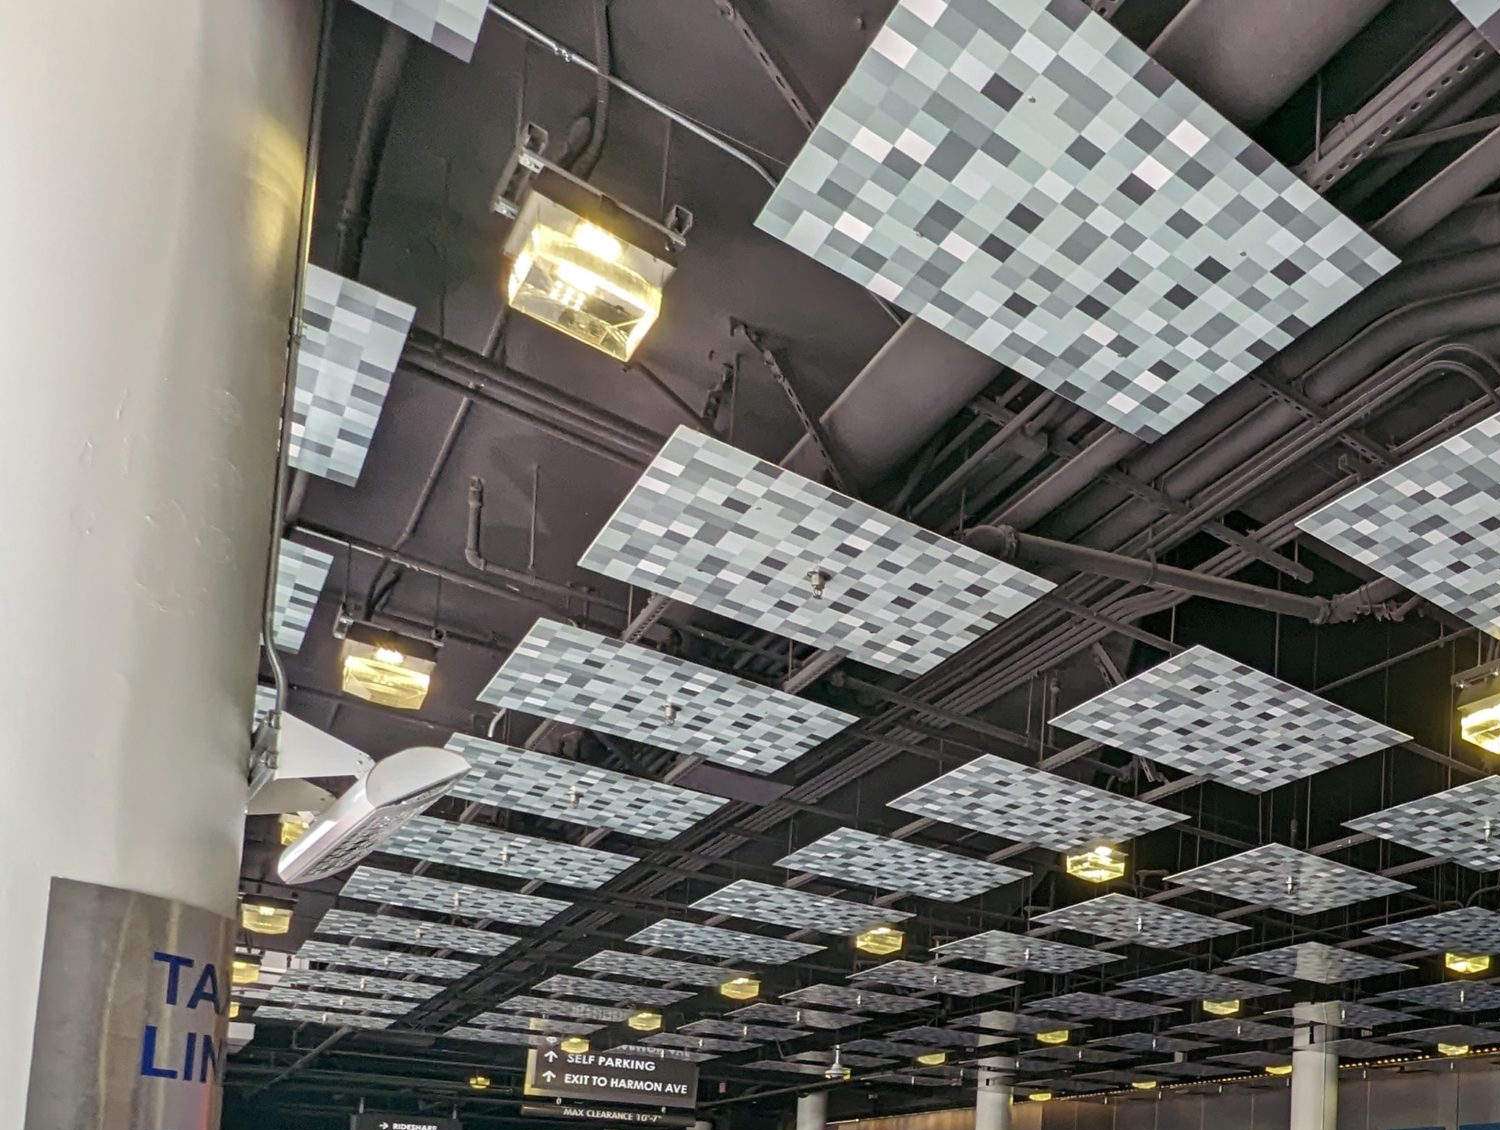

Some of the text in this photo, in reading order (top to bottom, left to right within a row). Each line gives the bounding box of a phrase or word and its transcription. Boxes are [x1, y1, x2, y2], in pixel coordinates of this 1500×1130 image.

[153, 951, 226, 1016] TA
[141, 1025, 222, 1083] LIN
[567, 1053, 656, 1072] SELF PARKING
[564, 1073, 689, 1095] EXIT TO HARMON AVE
[563, 1107, 584, 1117] MAX
[586, 1109, 634, 1121] CLEARANCE
